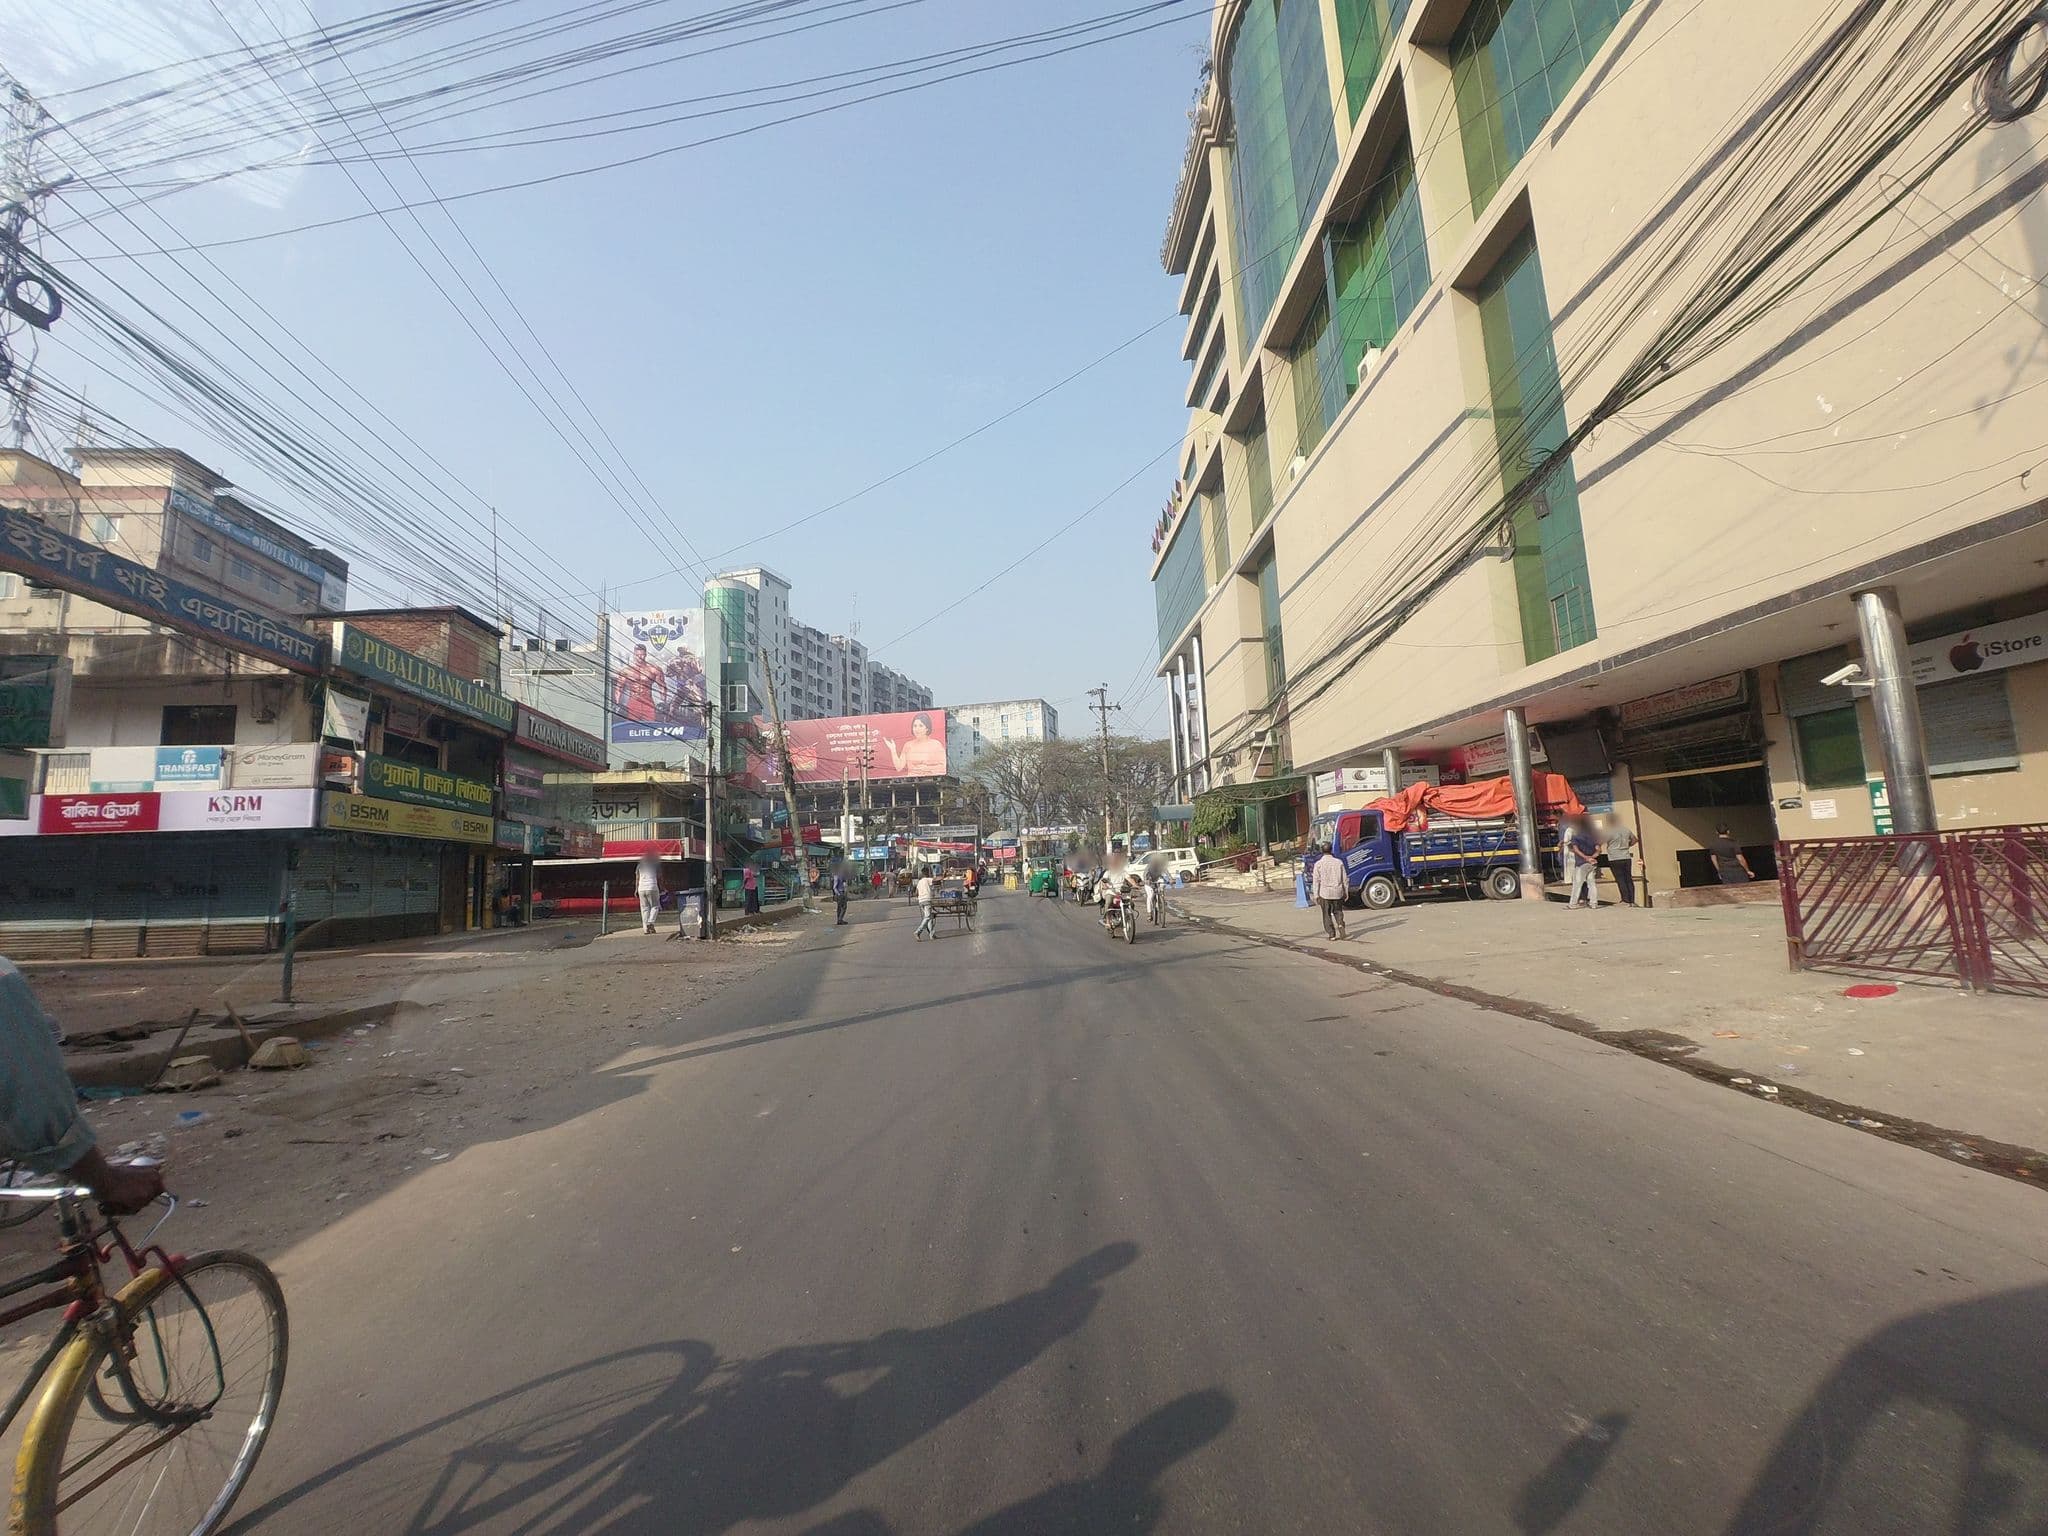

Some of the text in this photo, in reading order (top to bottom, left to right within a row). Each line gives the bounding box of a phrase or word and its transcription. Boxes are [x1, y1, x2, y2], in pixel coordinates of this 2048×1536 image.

[259, 537, 288, 563] HOTEL
[288, 554, 309, 577] STAR
[1983, 635, 2042, 658] iStore
[362, 638, 424, 686] PUBALI
[427, 666, 463, 702] BANK
[467, 685, 513, 722] LIMITED
[629, 726, 685, 737] ELITE GYM
[257, 753, 306, 762] MoneyGram
[61, 801, 141, 819] রাকিন ট্রেডার্স
[208, 796, 263, 814] KSRM
[350, 804, 389, 821] BSRM
[462, 820, 488, 833] BSRM
